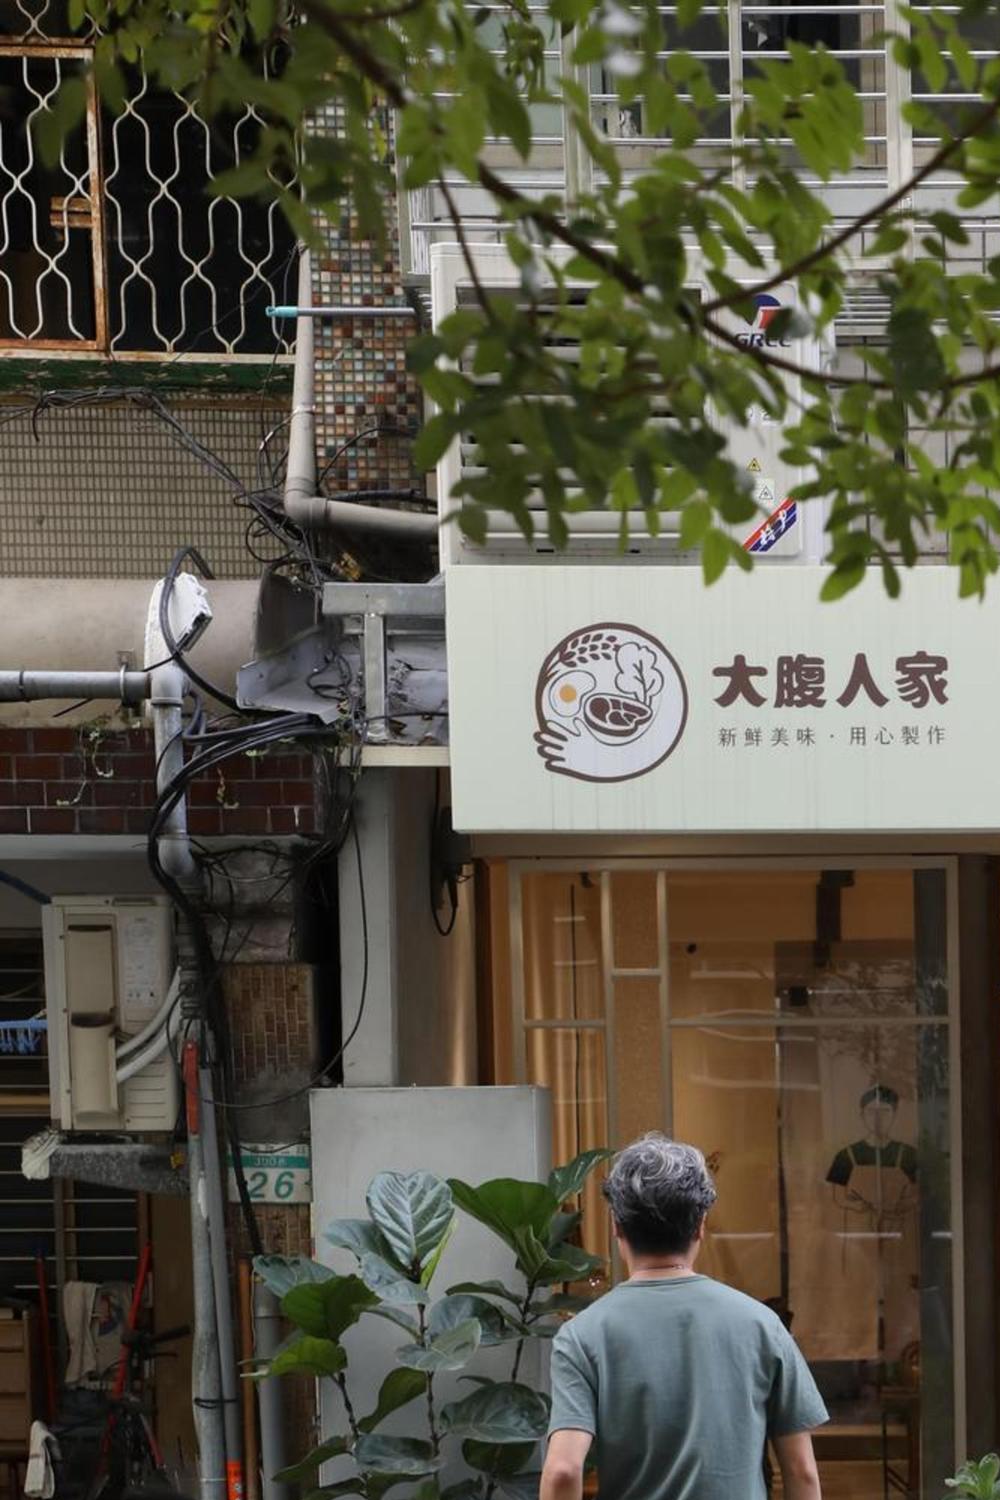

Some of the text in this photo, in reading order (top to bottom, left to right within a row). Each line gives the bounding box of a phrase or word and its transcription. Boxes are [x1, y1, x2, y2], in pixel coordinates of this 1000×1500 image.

[712, 651, 949, 708] 大腹人家
[250, 1171, 294, 1198] 26
